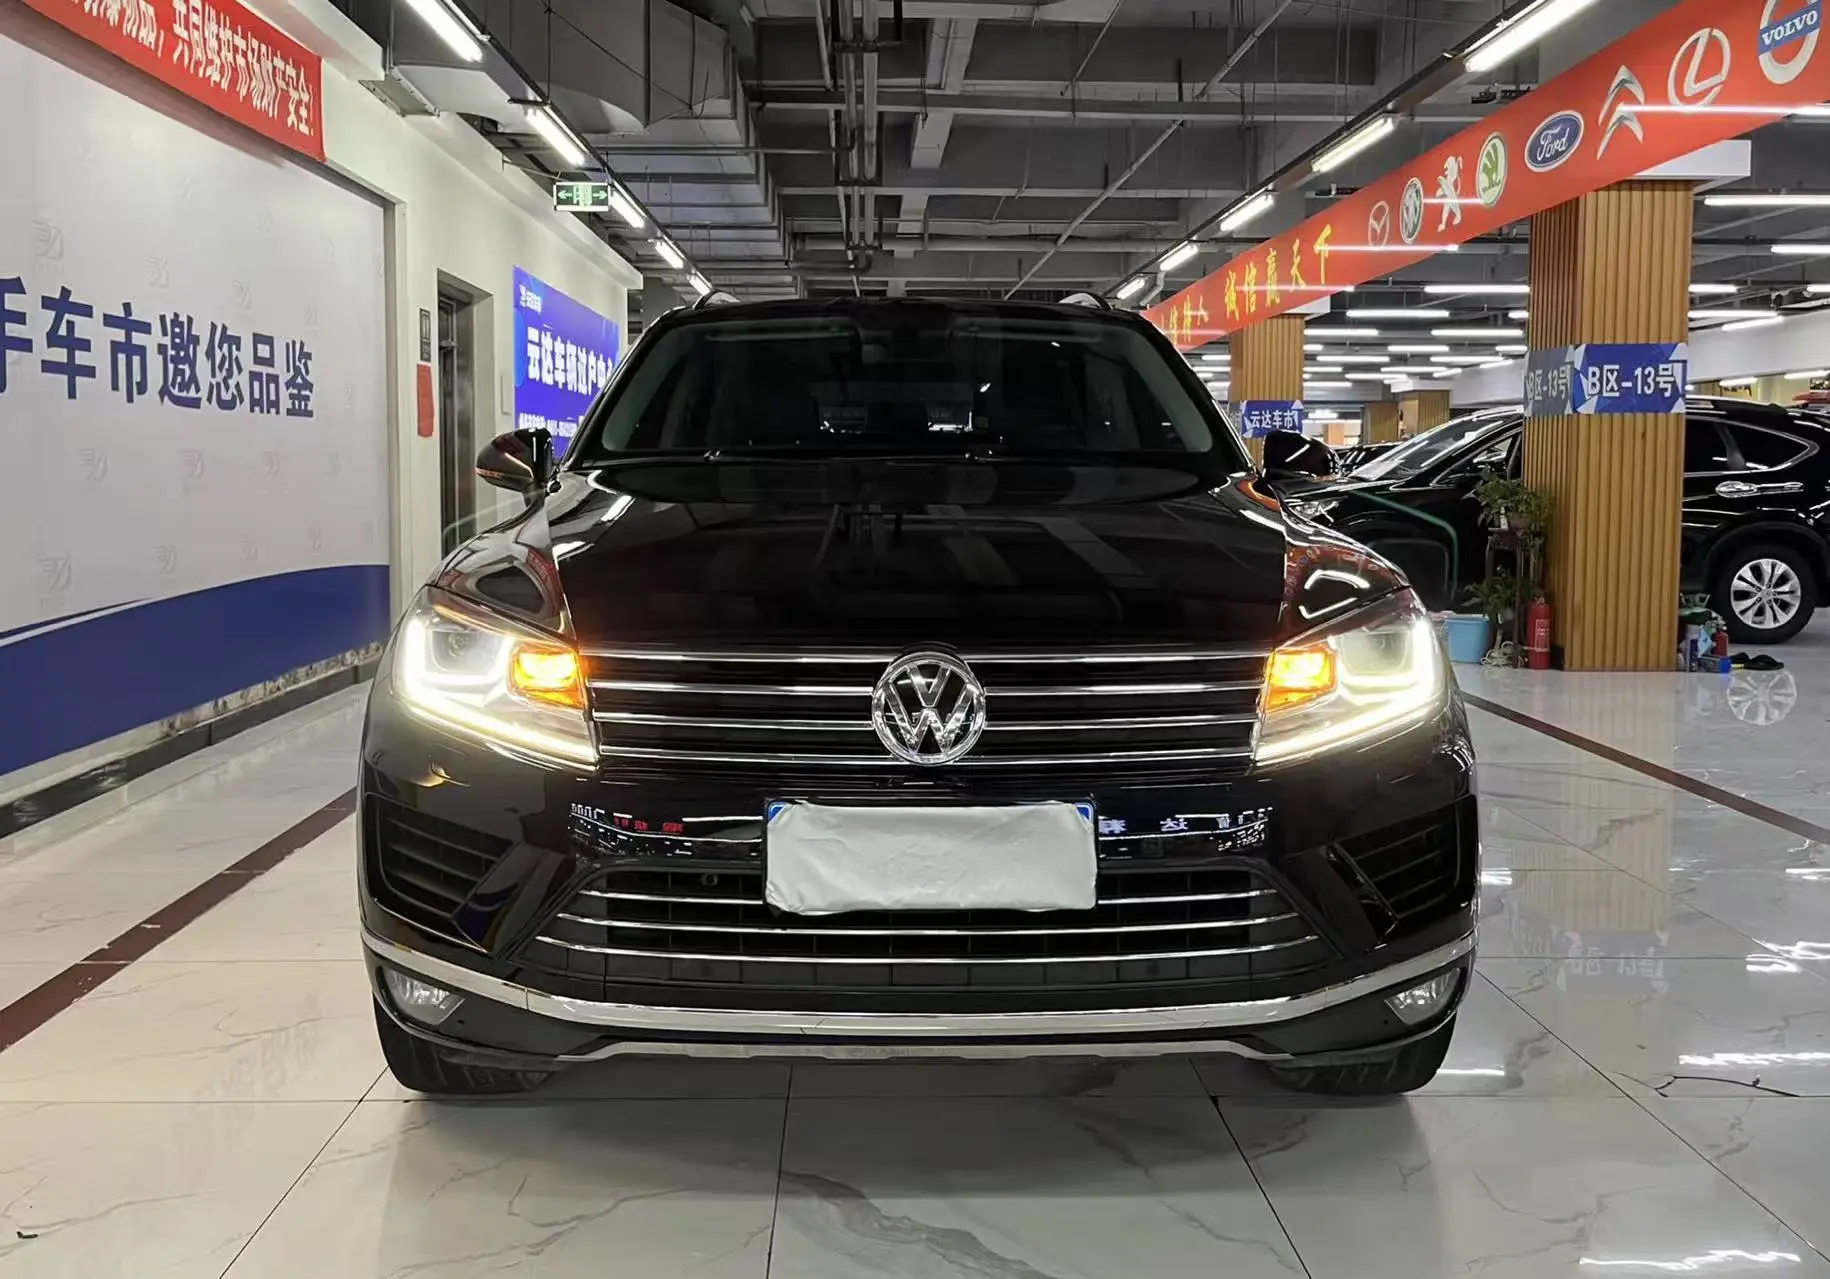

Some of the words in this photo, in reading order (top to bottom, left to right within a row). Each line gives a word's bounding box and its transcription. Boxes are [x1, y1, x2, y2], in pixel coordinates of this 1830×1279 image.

[1762, 10, 1818, 45] VOLVO
[1537, 124, 1570, 161] Ford
[1528, 366, 1569, 401] B区-13号
[1587, 363, 1675, 399] B区-13号
[1249, 409, 1294, 429] 云达车市
